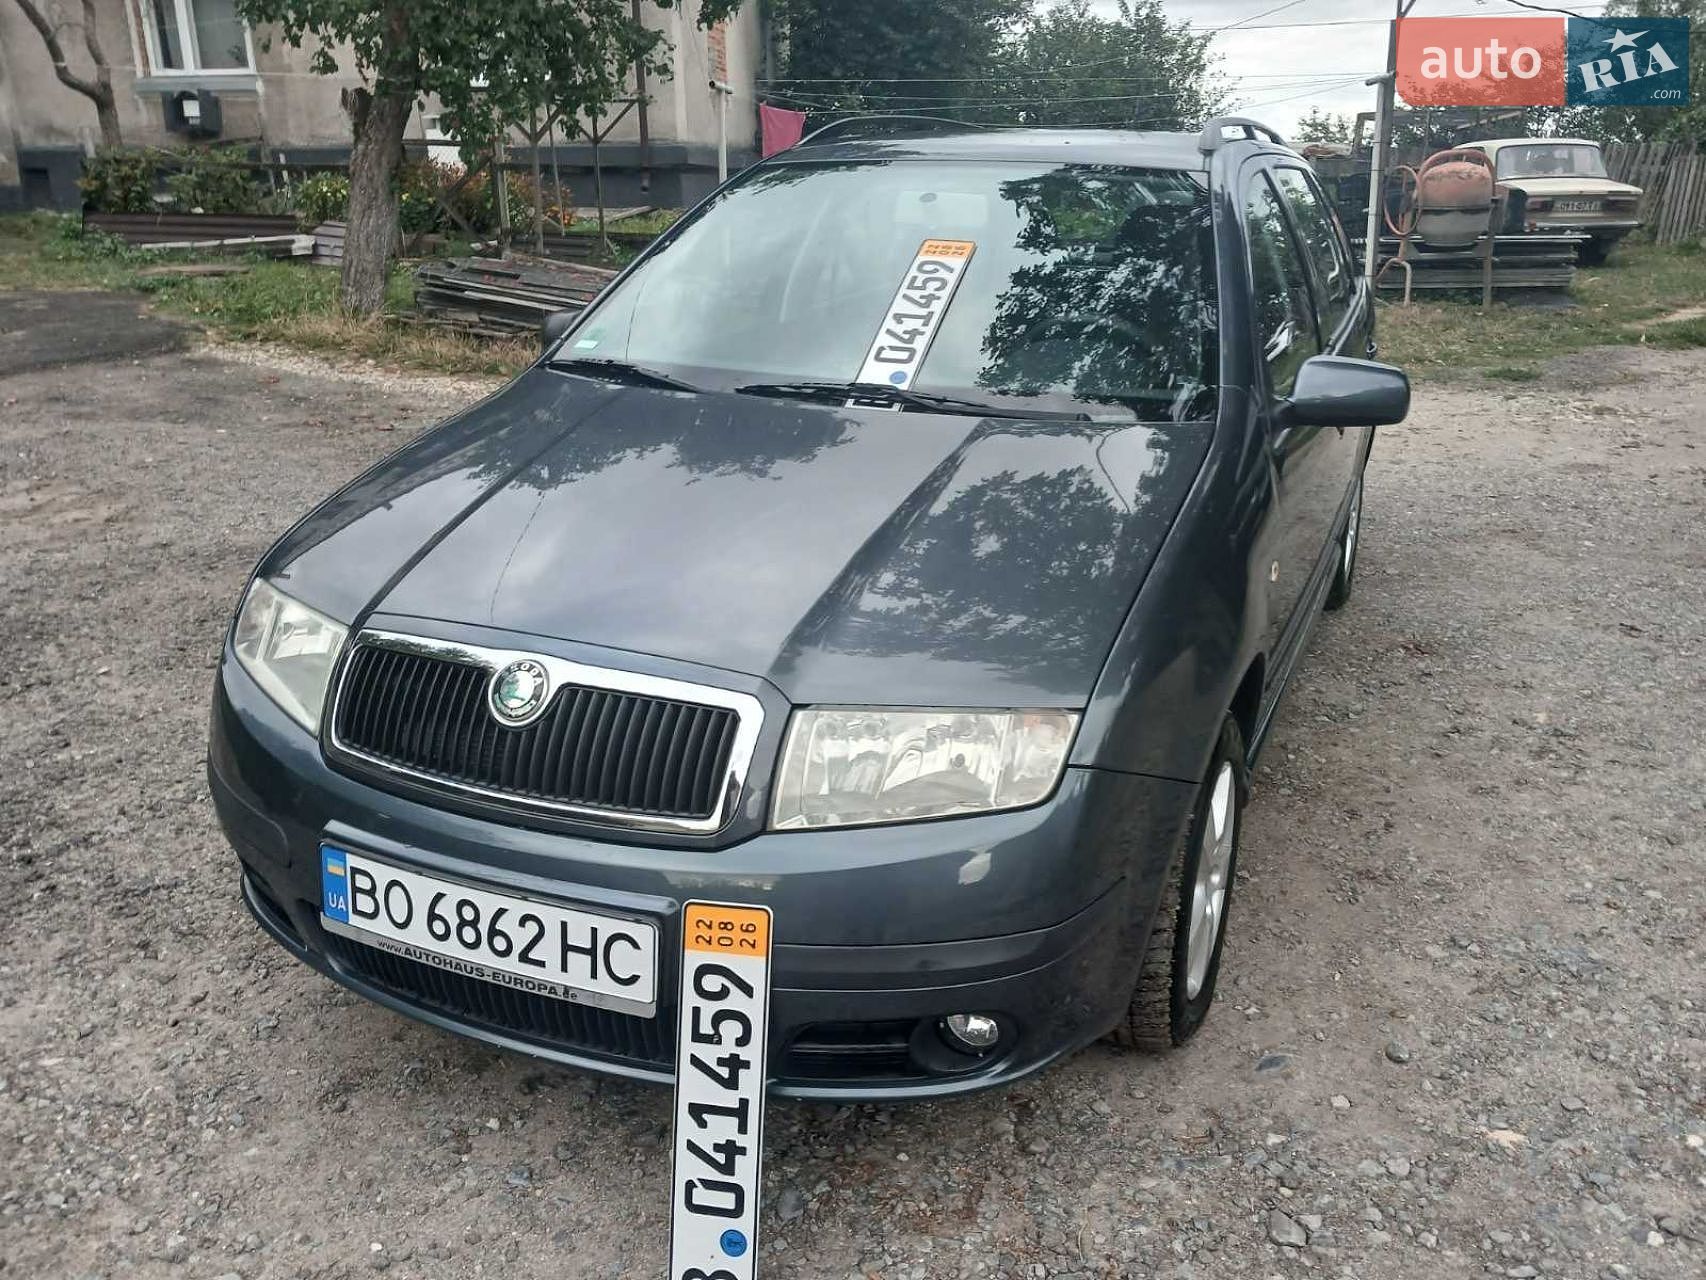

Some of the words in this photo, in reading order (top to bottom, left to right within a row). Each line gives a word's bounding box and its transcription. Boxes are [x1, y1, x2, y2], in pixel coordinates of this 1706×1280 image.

[873, 259, 955, 365] 041459
[328, 891, 347, 912] UA
[349, 865, 414, 931] BO
[426, 891, 547, 969] 6862
[560, 920, 642, 987] HC
[695, 918, 713, 946] 22
[717, 921, 735, 947] 08
[739, 922, 757, 949] 26
[684, 962, 754, 1219] 041459
